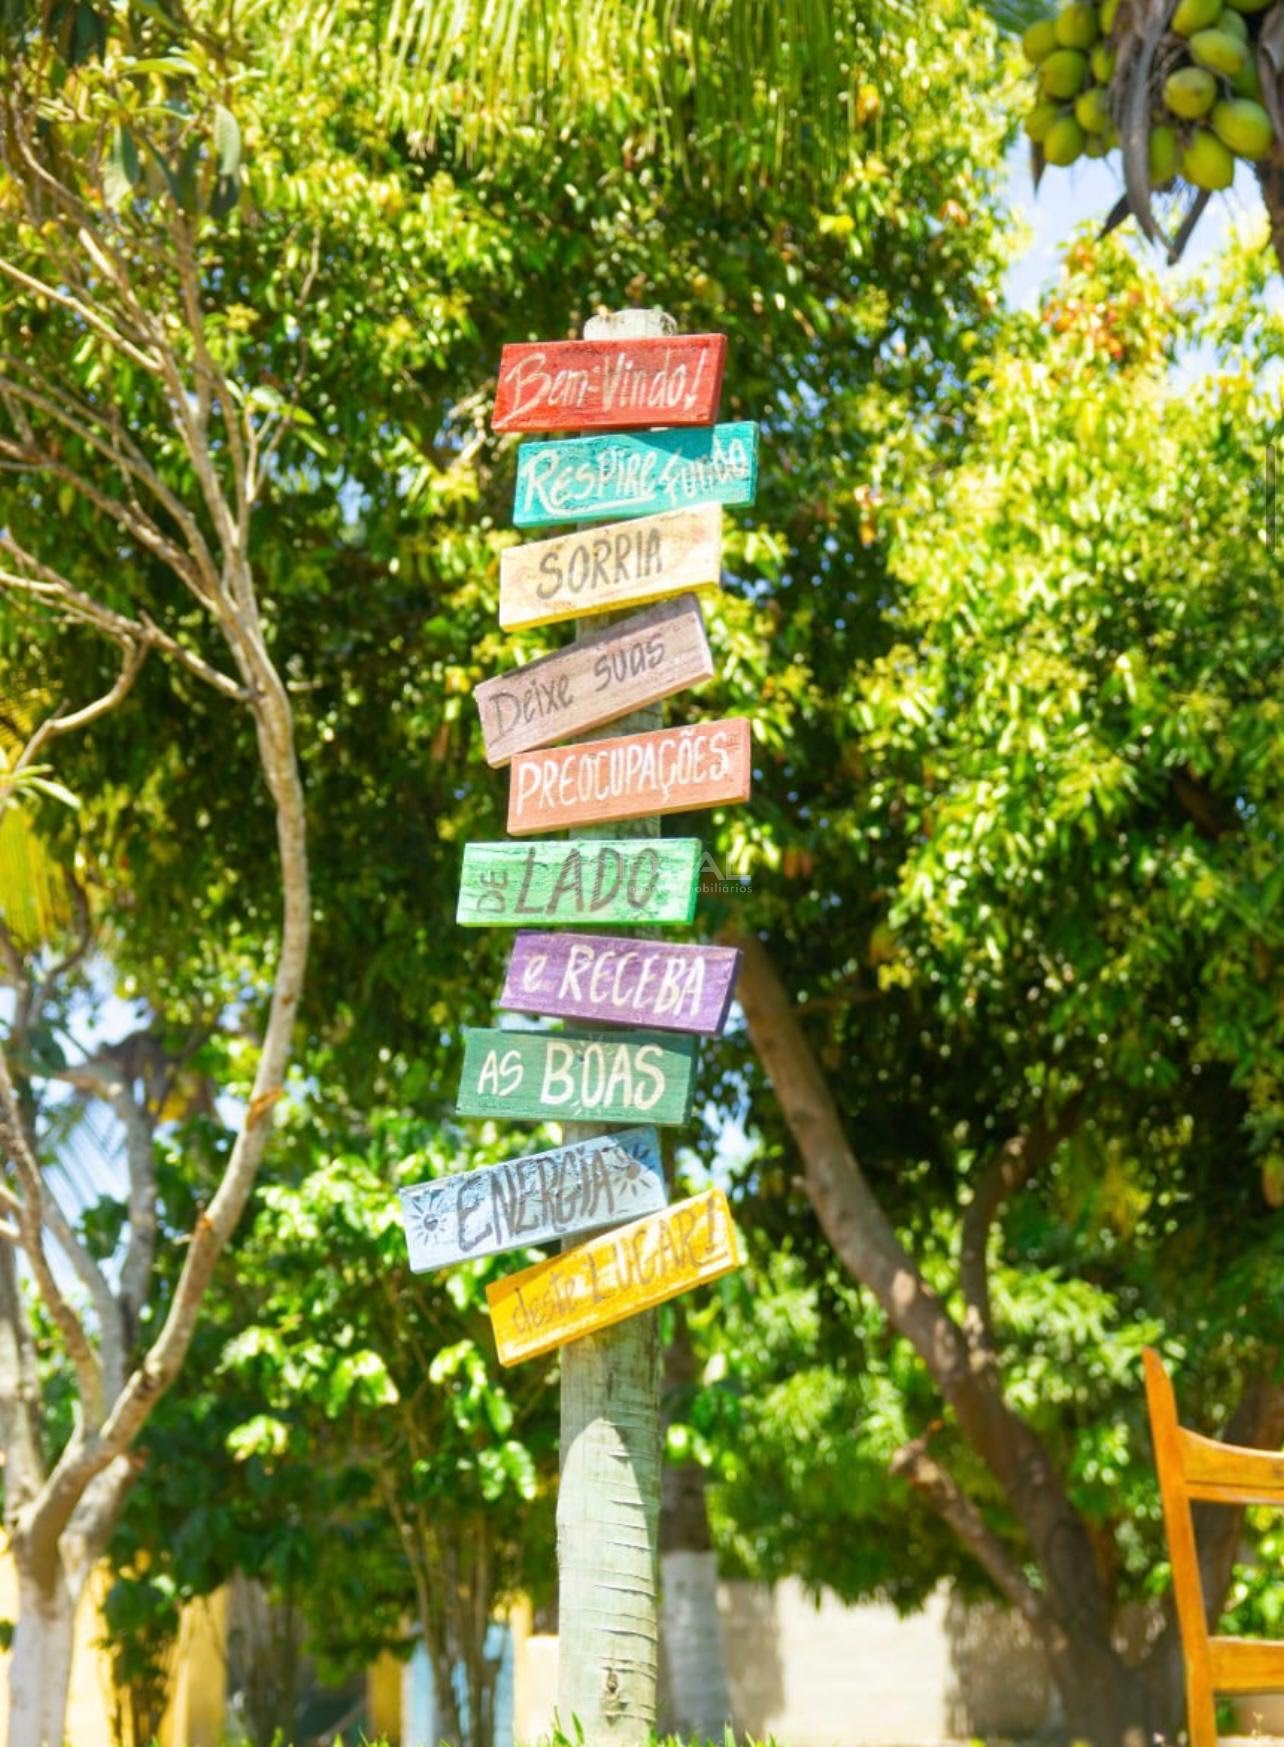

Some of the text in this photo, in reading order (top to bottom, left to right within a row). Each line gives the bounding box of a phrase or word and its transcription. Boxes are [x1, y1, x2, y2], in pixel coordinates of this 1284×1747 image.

[536, 527, 662, 600] SORRIA
[487, 673, 574, 749] Deixe
[516, 729, 731, 817] PREOCUPAÇÕES
[513, 846, 660, 916] LADO
[558, 943, 706, 1018] RECEBA
[477, 1041, 667, 1111] AS BOAS
[456, 1146, 615, 1253] ENERGIA
[587, 1196, 729, 1305] LUGAR!
